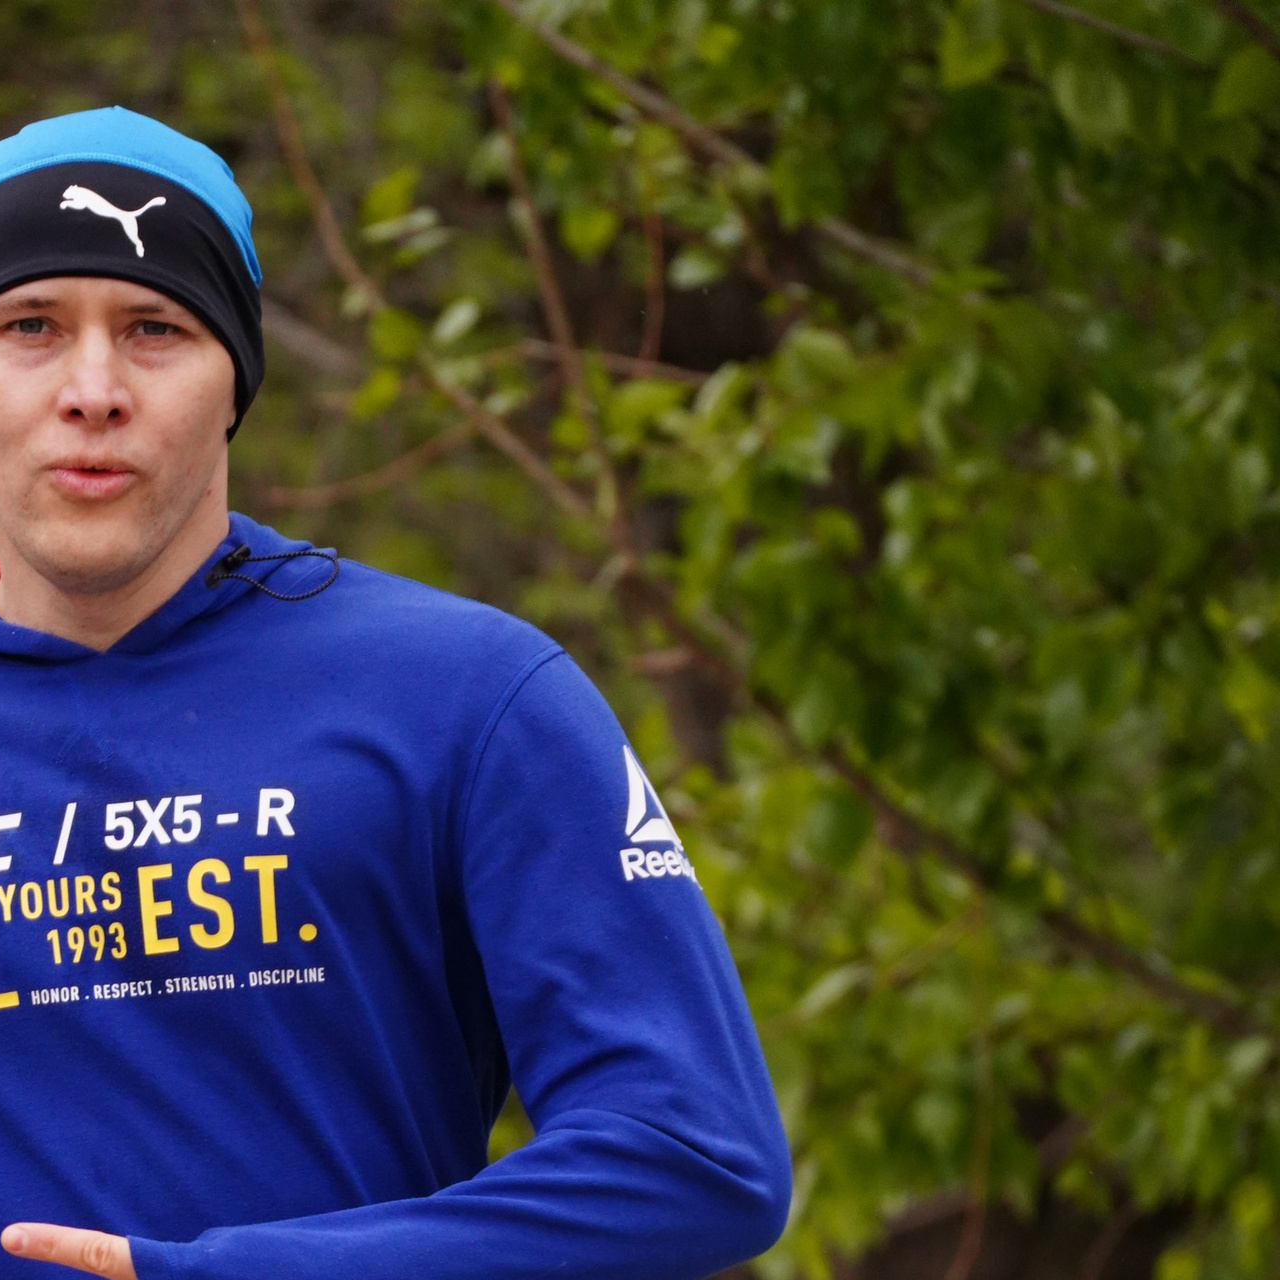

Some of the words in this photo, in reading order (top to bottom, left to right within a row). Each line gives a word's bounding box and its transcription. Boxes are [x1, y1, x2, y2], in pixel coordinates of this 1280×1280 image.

[53, 802, 77, 865] /
[104, 794, 202, 850] 5X5
[257, 788, 295, 836] R
[137, 855, 317, 955] EST.
[46, 922, 127, 964] 1993
[31, 986, 79, 1005] HONOR
[93, 981, 152, 999] RESPECT
[165, 974, 234, 993] STRENGTH
[249, 967, 325, 987] DISCIPLINE
